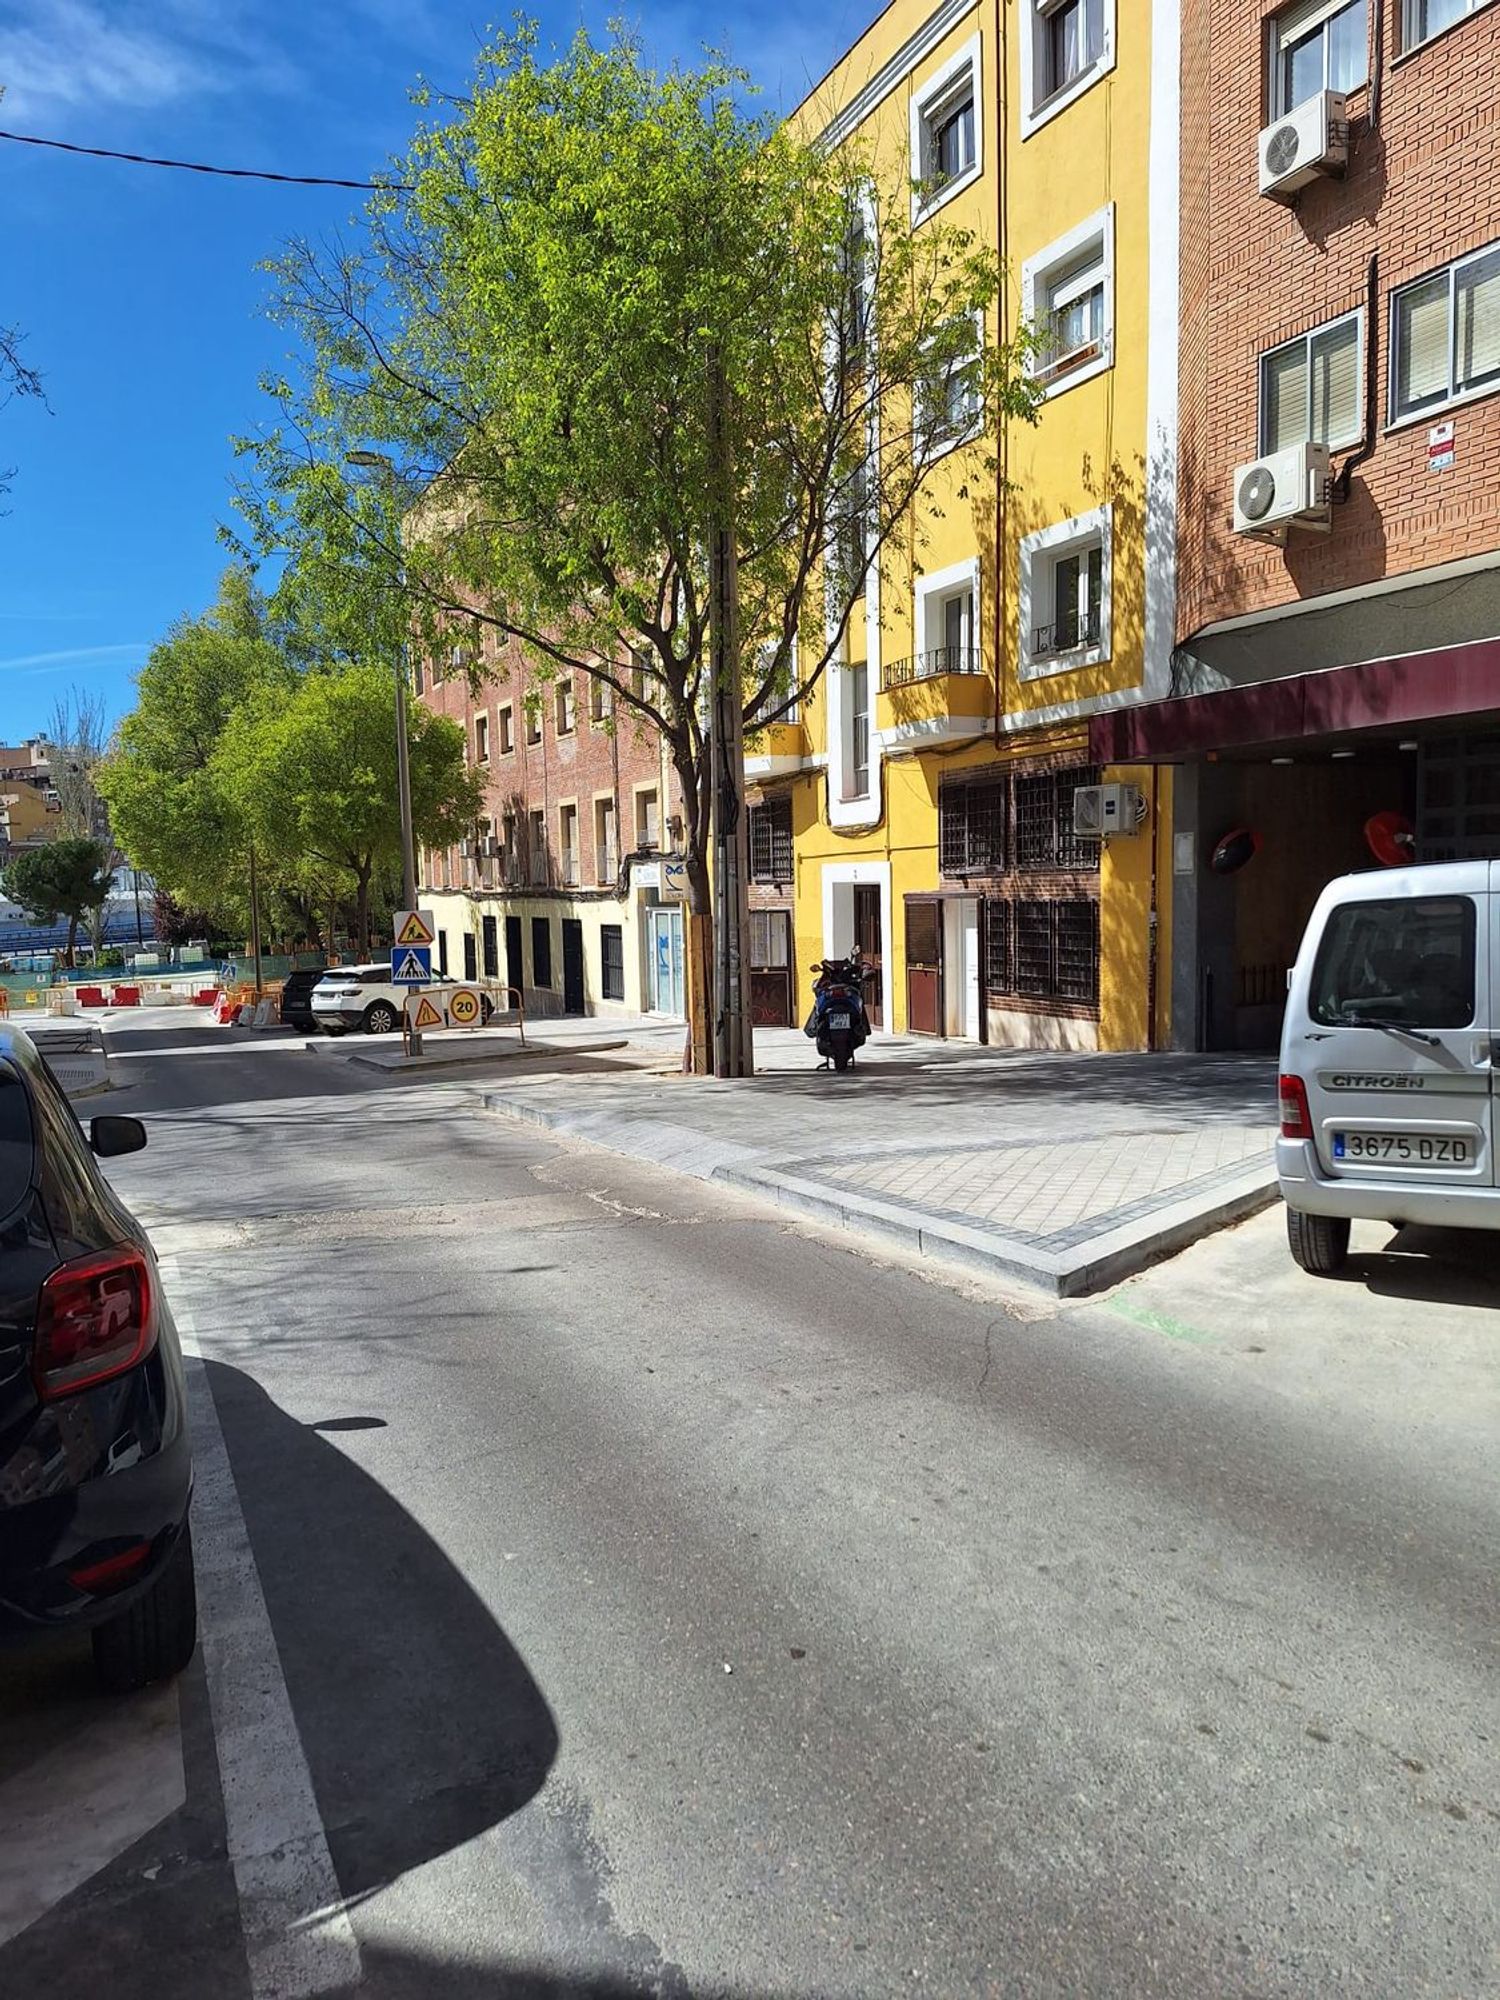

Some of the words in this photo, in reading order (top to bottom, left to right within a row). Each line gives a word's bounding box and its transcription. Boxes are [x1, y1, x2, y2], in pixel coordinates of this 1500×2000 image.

[456, 1001, 473, 1013] 20
[1331, 1073, 1425, 1089] CITROËN
[1350, 1136, 1411, 1159] 3675
[1419, 1139, 1467, 1162] DZD
